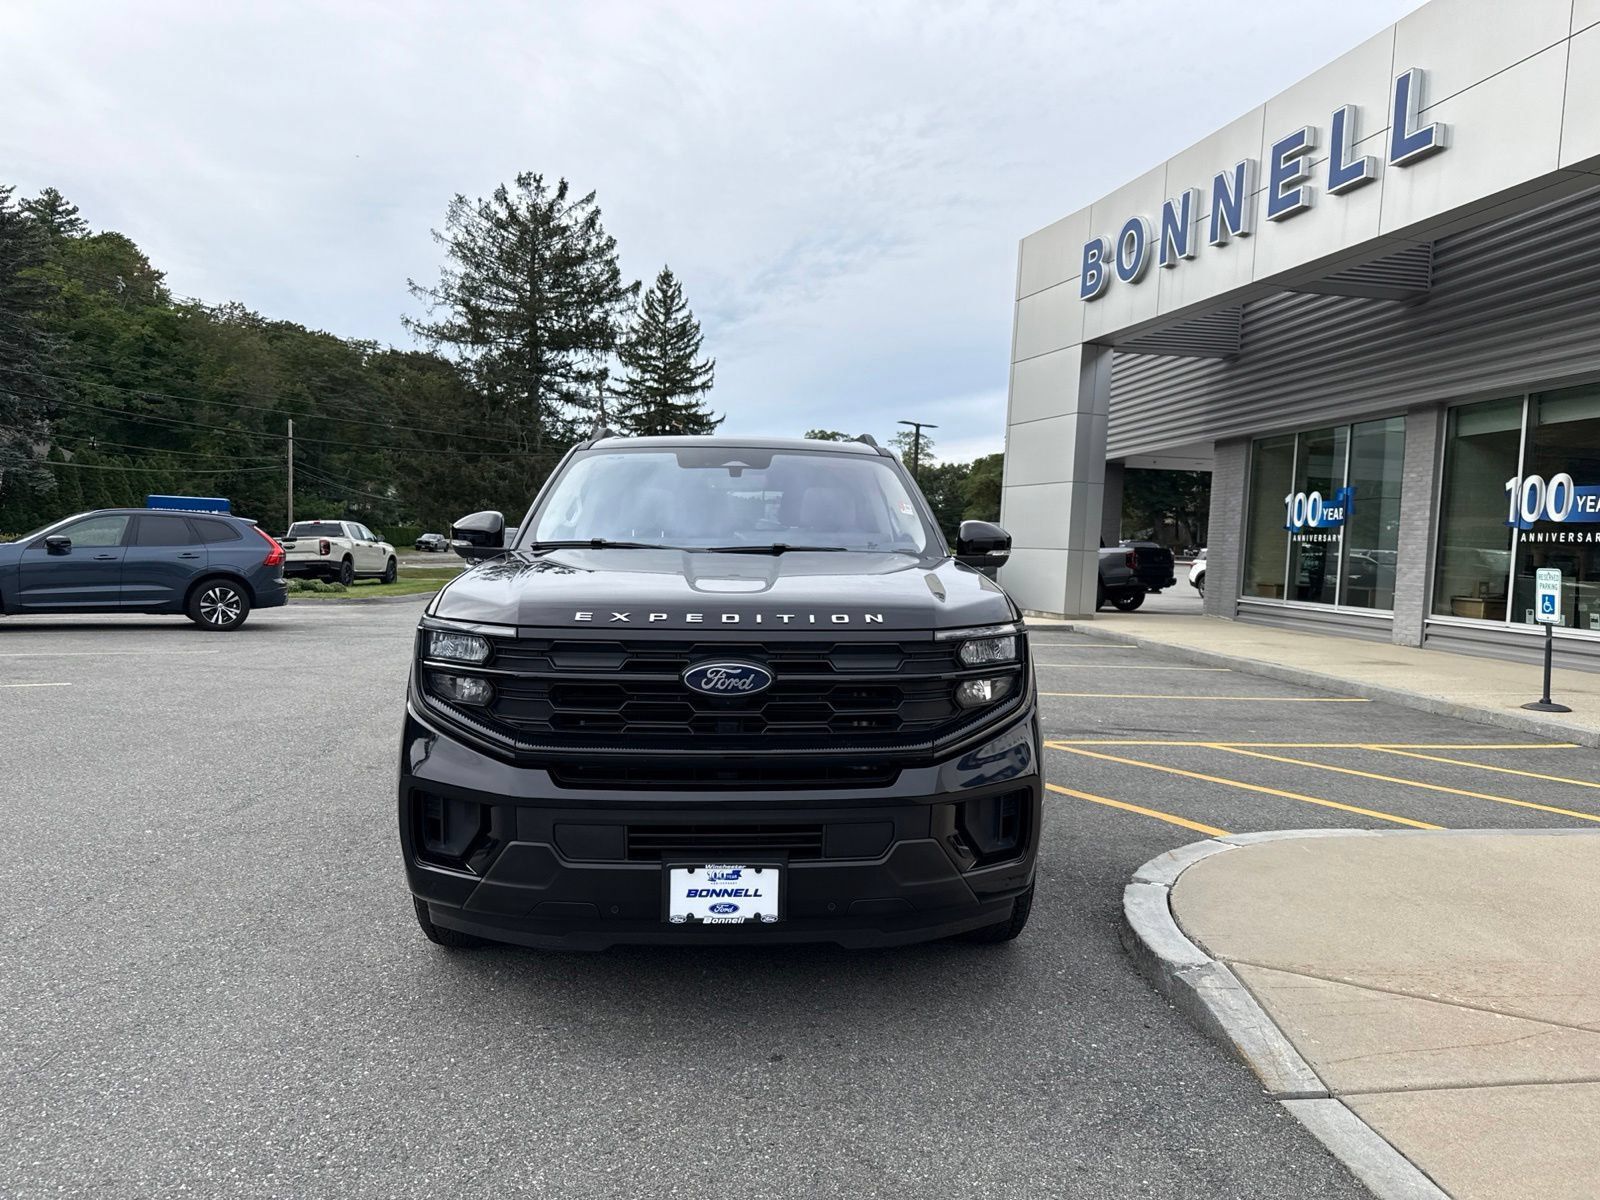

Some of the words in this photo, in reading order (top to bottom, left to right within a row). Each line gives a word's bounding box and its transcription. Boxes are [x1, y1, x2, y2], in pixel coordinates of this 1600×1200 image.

[1080, 67, 1446, 302] BONNELL
[1505, 472, 1574, 523] 100
[1285, 491, 1322, 528] 100
[1293, 534, 1342, 542] ANNIVERSARY
[1520, 532, 1600, 543] ANNIVERSAR
[1538, 574, 1559, 582] RESERVED
[1539, 582, 1558, 591] PARKING
[574, 611, 885, 624] EXPEDITION
[701, 666, 756, 691] Ford
[686, 888, 763, 898] BONNELL
[713, 903, 735, 914] Ford
[702, 916, 745, 924] Bonnell
